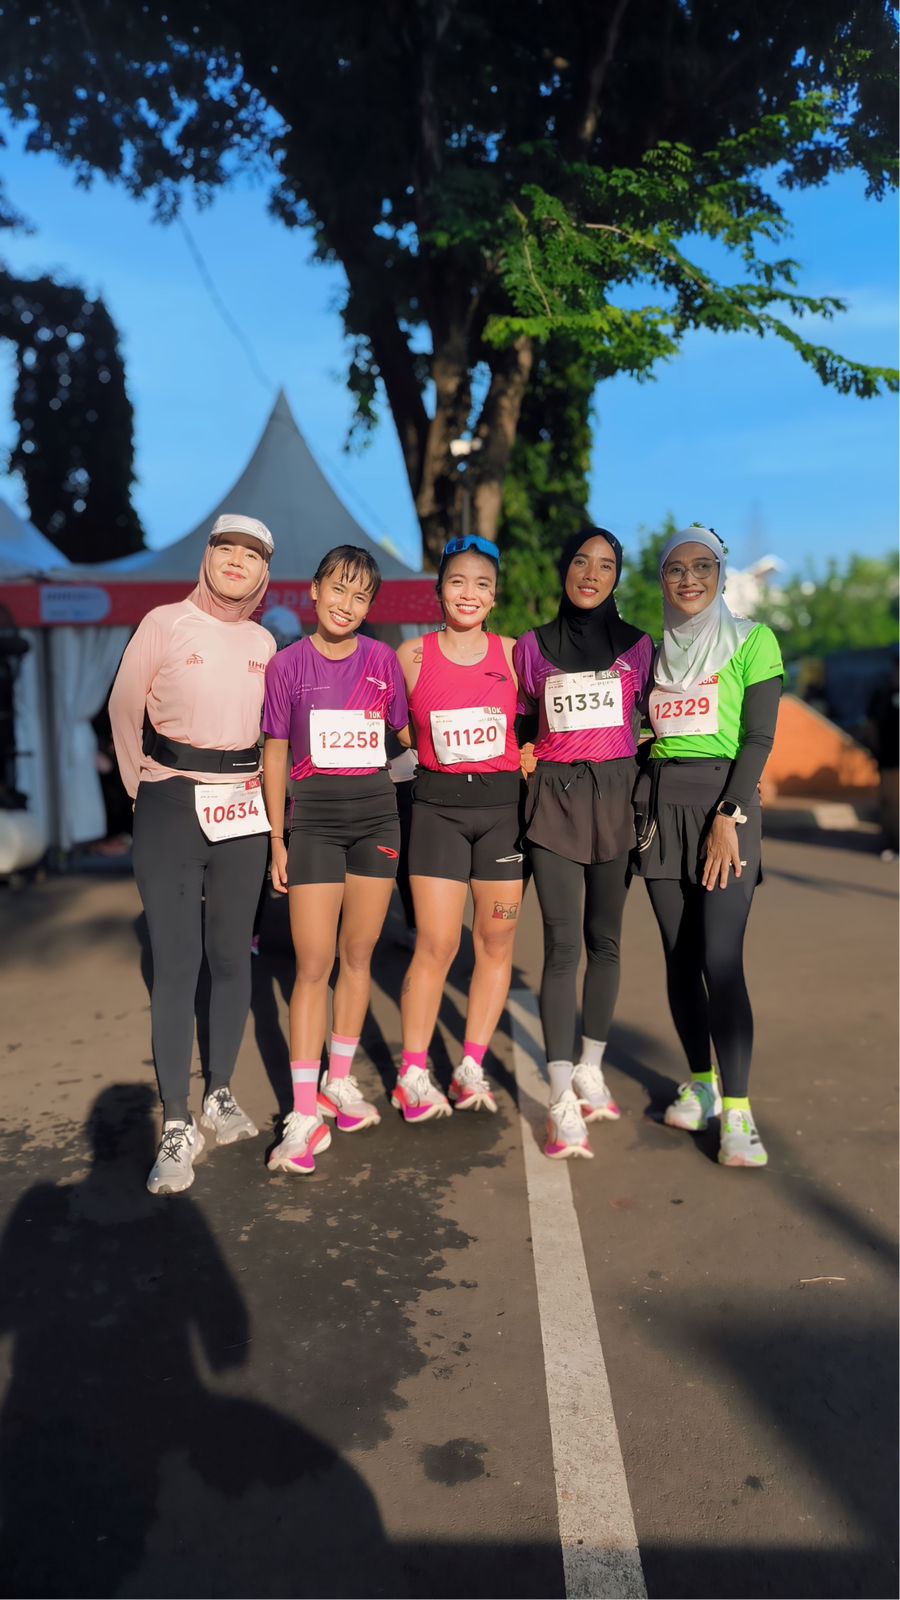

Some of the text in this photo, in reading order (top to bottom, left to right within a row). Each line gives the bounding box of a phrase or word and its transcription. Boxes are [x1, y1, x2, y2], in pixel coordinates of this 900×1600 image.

[489, 706, 502, 714] 10K
[553, 691, 614, 713] 51334
[655, 697, 710, 720] 12329
[369, 711, 381, 719] 10K
[319, 731, 379, 749] 12258
[443, 726, 497, 747] 11120
[203, 800, 259, 824] 10634
